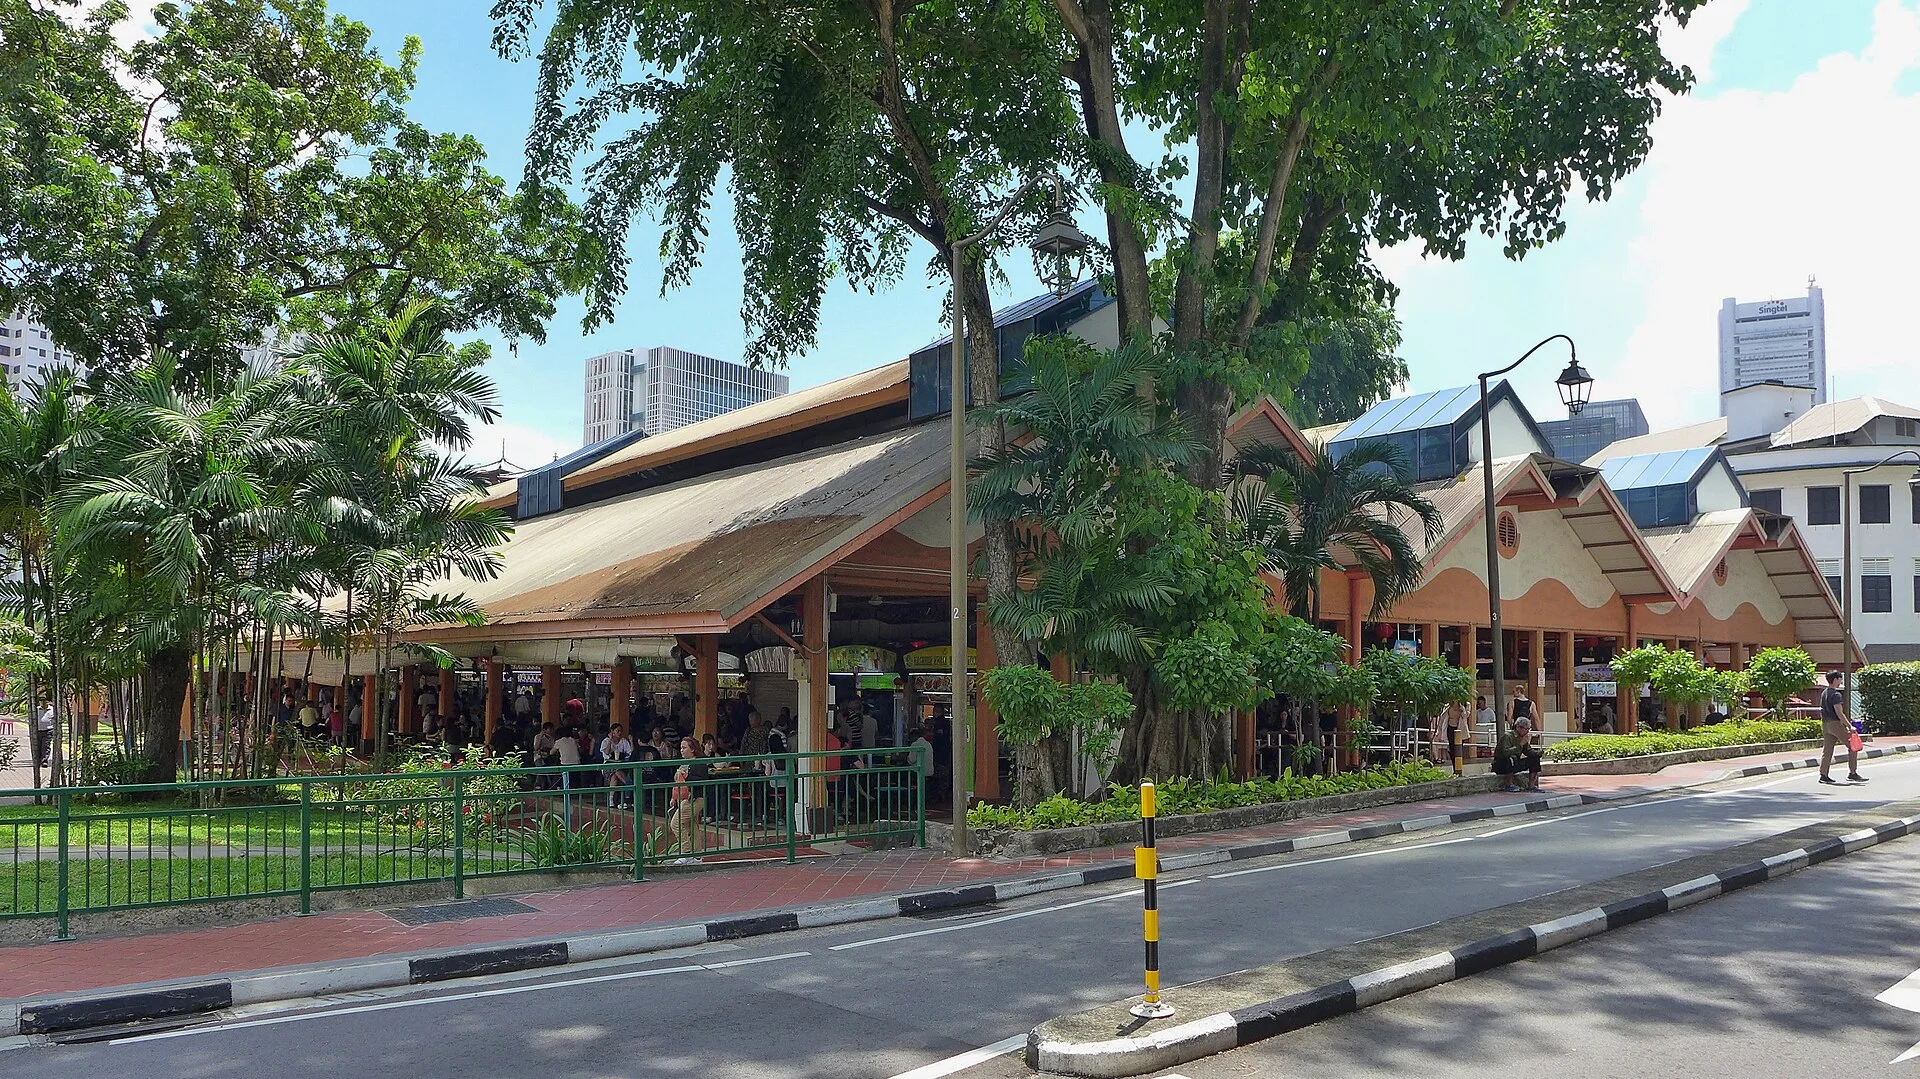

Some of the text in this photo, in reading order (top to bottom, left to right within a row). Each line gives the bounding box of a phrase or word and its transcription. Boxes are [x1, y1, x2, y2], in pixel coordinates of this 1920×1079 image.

[1758, 305, 1787, 314] Singtel
[953, 607, 959, 619] 2
[1492, 612, 1497, 621] 3
